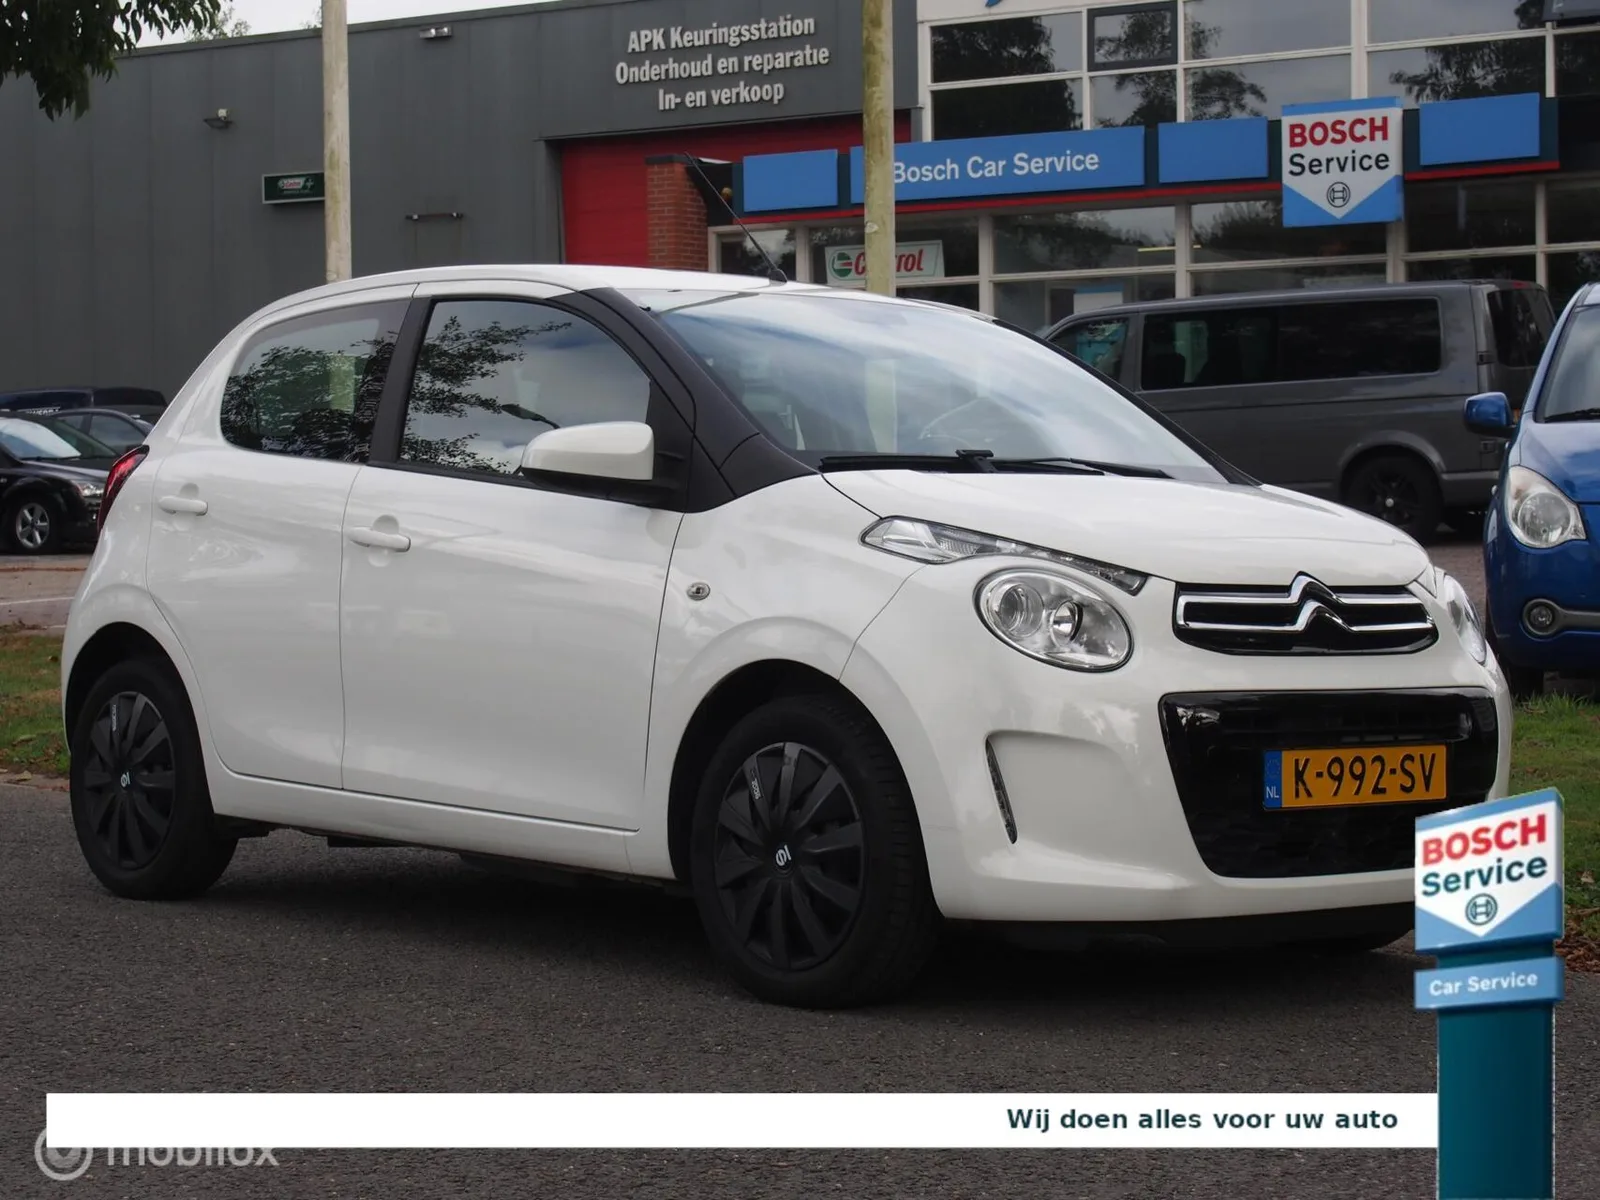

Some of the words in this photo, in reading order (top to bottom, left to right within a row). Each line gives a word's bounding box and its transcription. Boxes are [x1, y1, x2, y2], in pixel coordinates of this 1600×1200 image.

[627, 28, 666, 53] APK
[669, 14, 816, 49] Keuringsstation
[615, 54, 713, 84] Onderhoud
[717, 55, 739, 75] en
[743, 44, 830, 75] reparatie
[658, 89, 681, 111] In-
[684, 90, 706, 108] en
[711, 81, 785, 106] verkoop
[1288, 115, 1389, 148] BOSCH
[893, 158, 960, 183] Bosch
[966, 156, 1006, 179] Car
[1013, 150, 1100, 176] Service
[1288, 150, 1390, 177] Service
[854, 248, 924, 276] Crol
[1294, 753, 1436, 798] K-992-SV
[1266, 786, 1280, 799] NL
